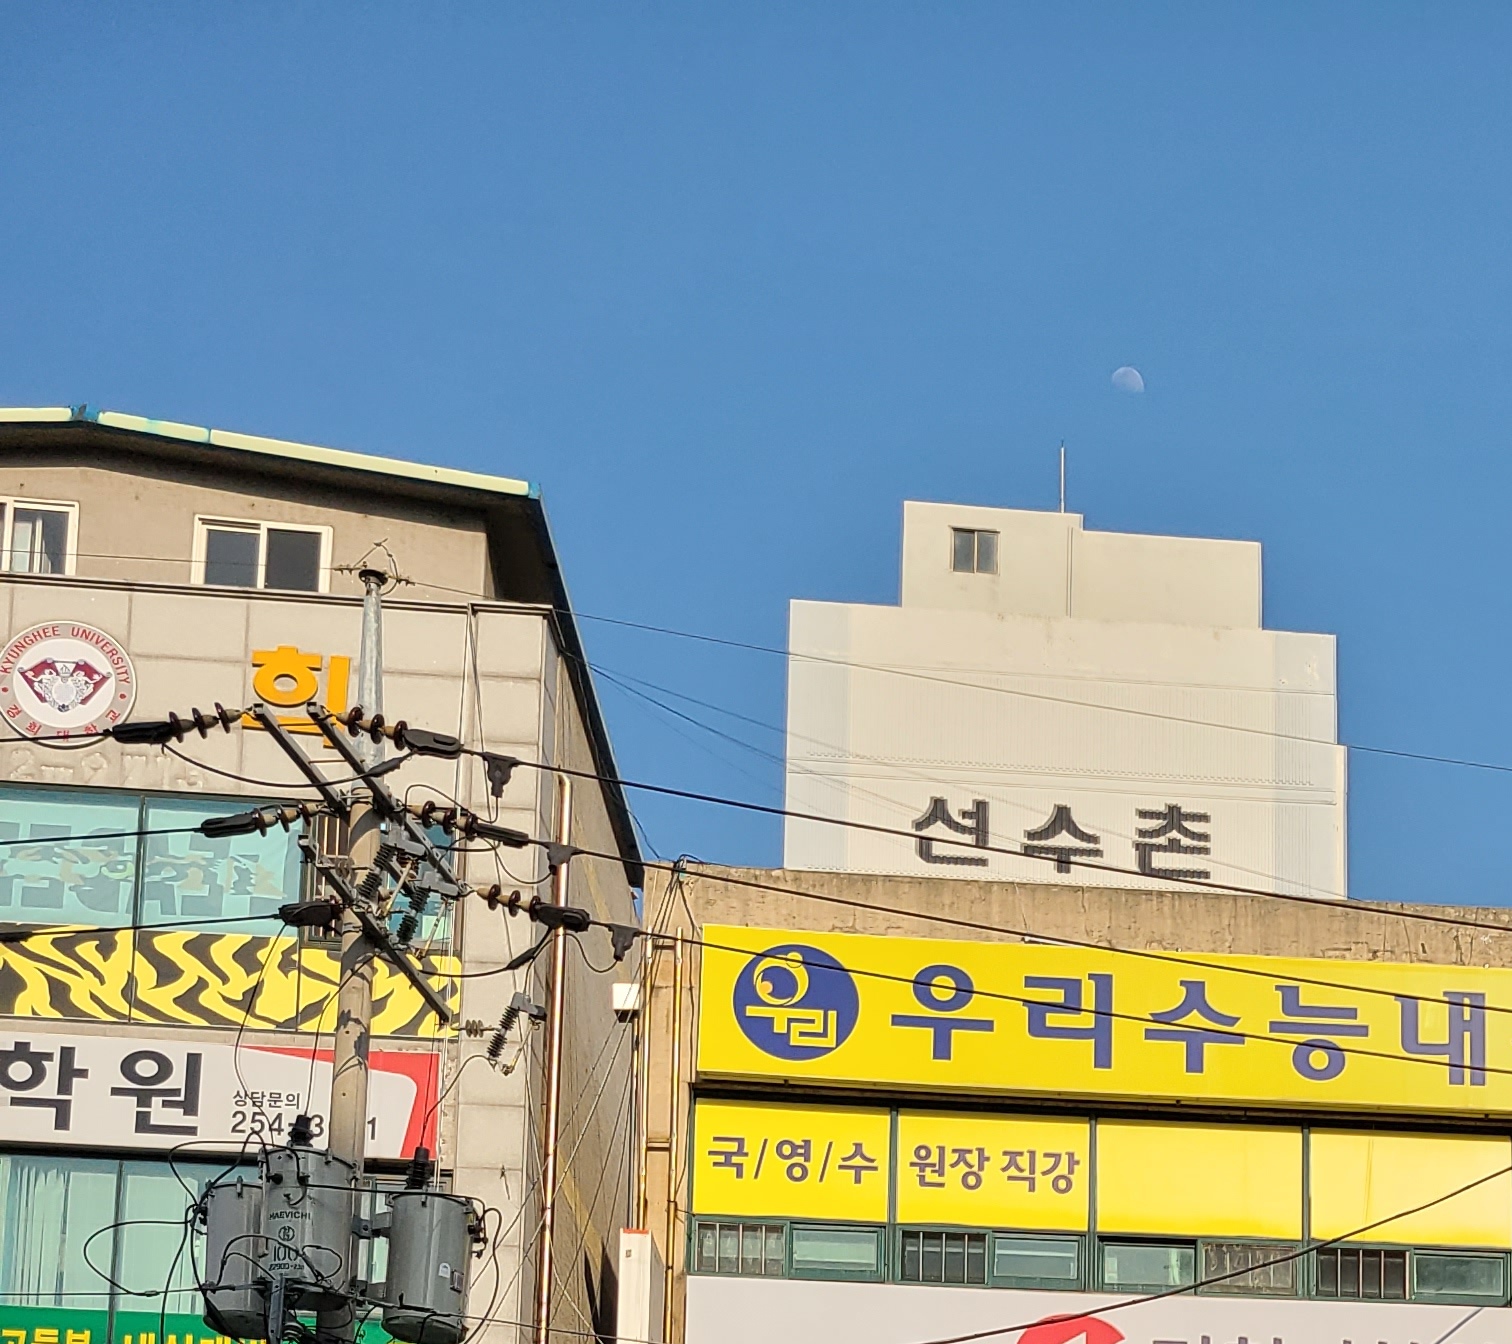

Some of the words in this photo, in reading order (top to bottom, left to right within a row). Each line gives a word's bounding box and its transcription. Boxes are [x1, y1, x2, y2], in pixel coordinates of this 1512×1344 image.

[1, 626, 61, 675] KYUNGHEE
[71, 626, 131, 684] UNIVERSITY
[912, 796, 1211, 879] 선수촌
[232, 1090, 301, 1110] 상담문의
[708, 1136, 879, 1184] 국/영/수
[909, 1144, 990, 1190] 원장
[1000, 1148, 1081, 1195] 직강
